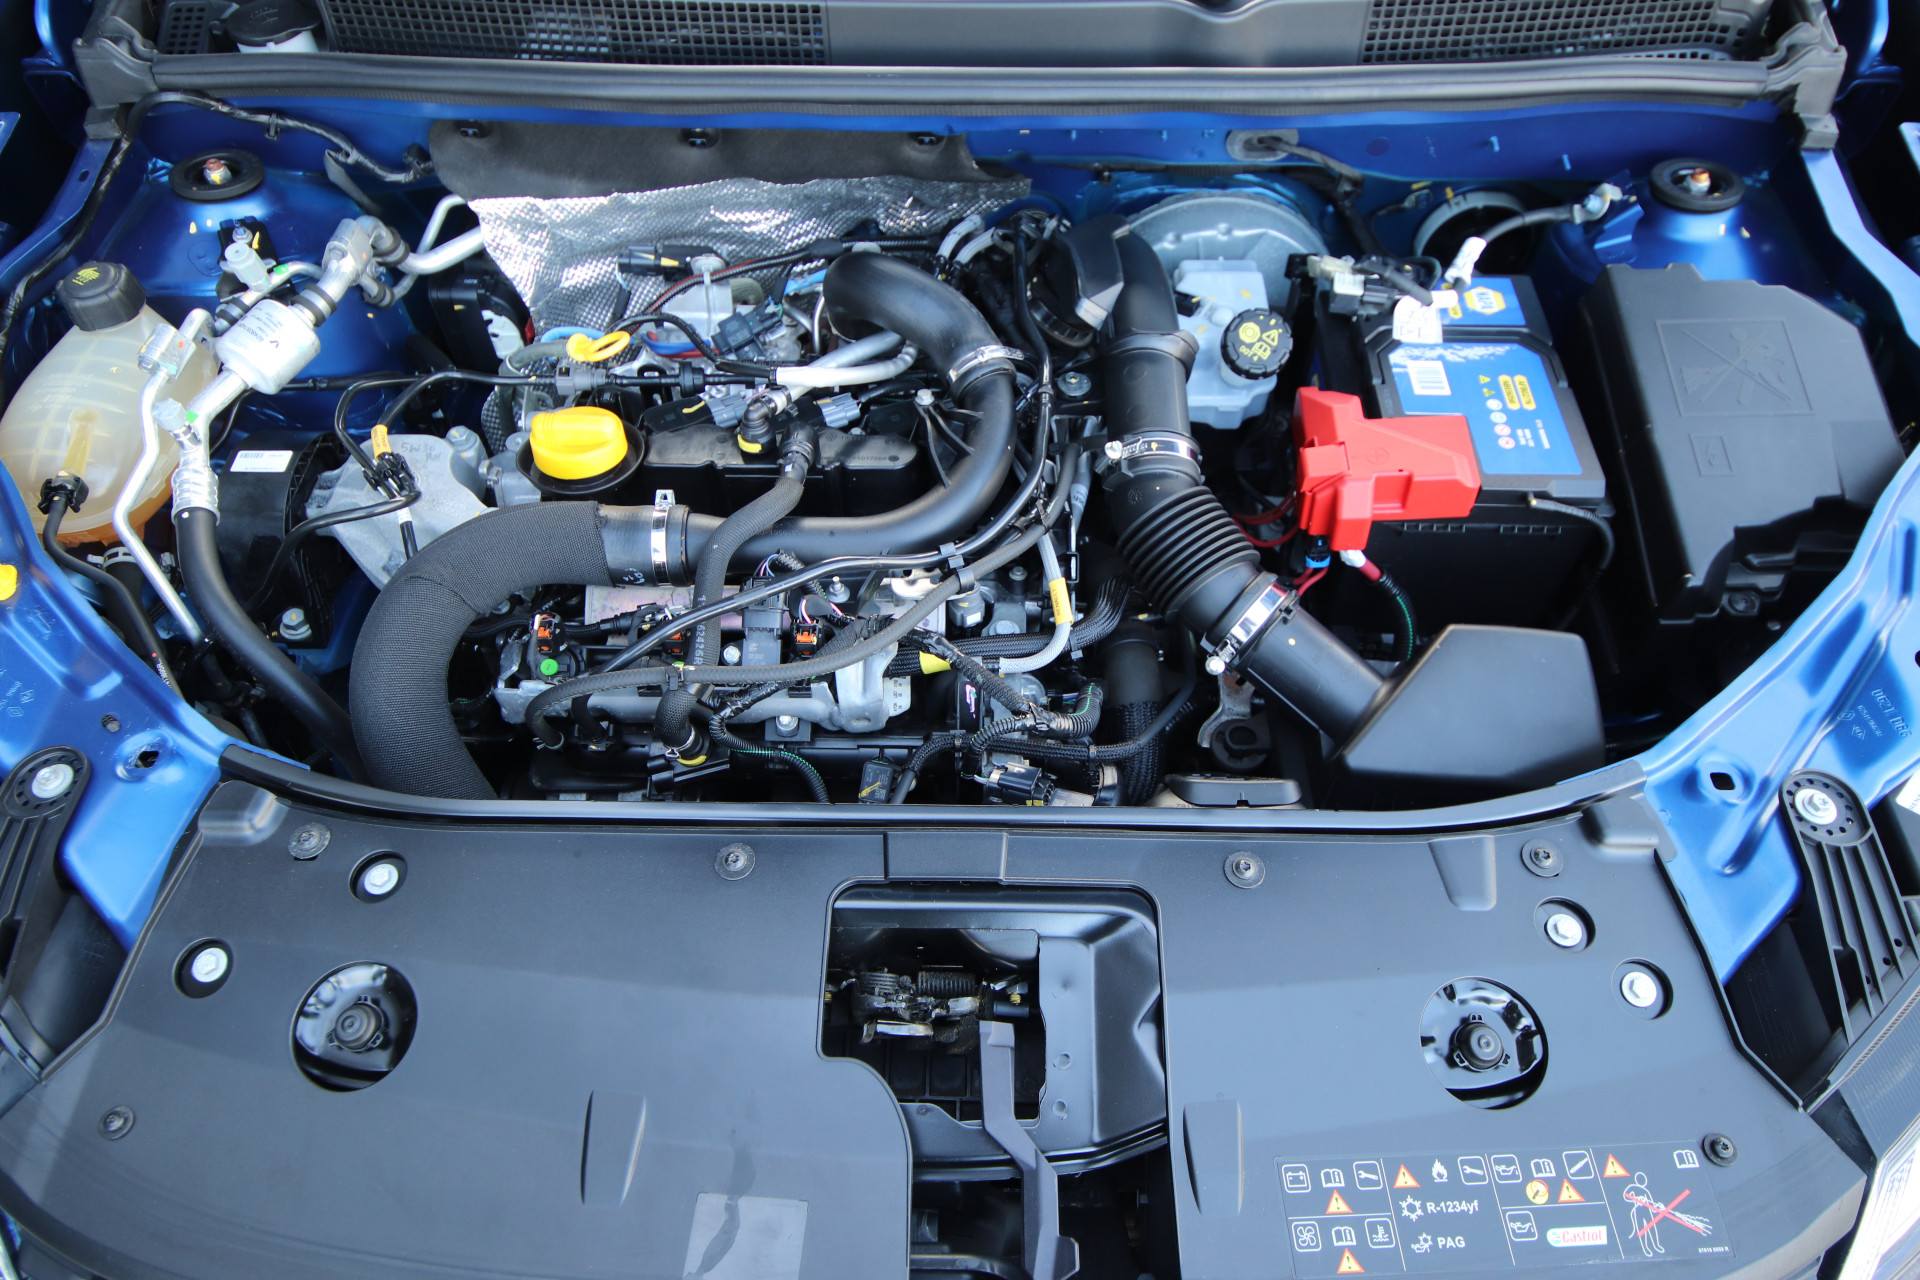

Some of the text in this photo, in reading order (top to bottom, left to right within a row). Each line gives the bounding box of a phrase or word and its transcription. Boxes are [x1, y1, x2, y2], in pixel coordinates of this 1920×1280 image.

[1475, 291, 1496, 309] NAPA
[1239, 345, 1259, 362] DOT 4
[1426, 1200, 1479, 1215] R-1234yf
[1437, 1235, 1466, 1249] PAG
[1562, 1229, 1602, 1243] Castrol
